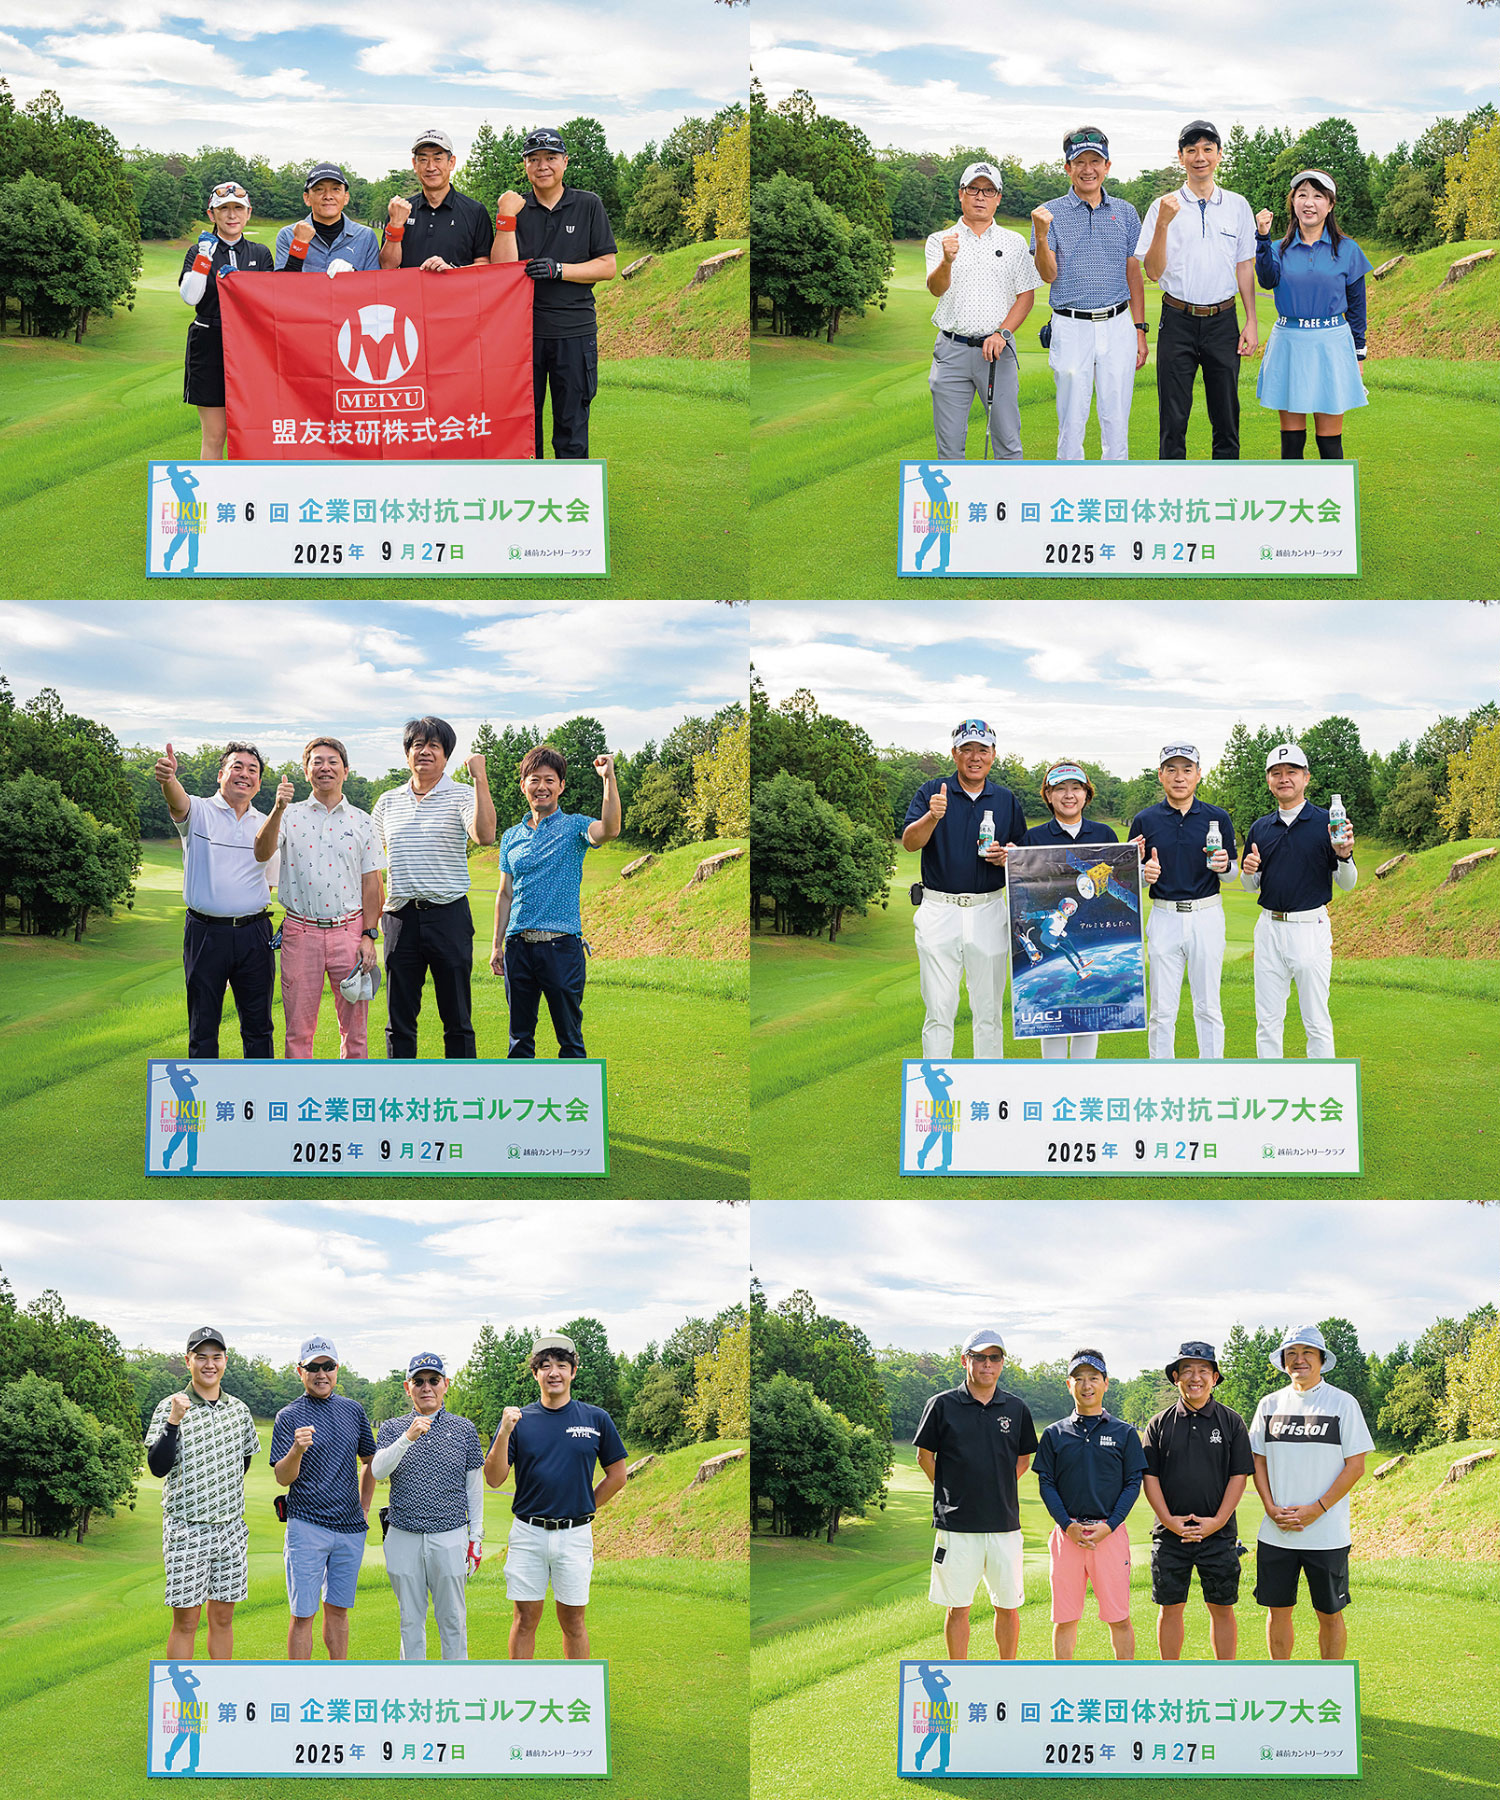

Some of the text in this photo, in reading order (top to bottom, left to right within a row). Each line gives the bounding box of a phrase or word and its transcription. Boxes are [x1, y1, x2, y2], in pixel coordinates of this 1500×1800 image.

[341, 392, 419, 408] MEIYU
[272, 412, 492, 446] 盟友技研株式会社
[162, 502, 207, 520] FUKUI
[913, 501, 958, 519] FUKUI
[162, 526, 207, 534] TOURNAMENT
[913, 525, 958, 534] TOURNAMENT
[524, 549, 591, 557] 越前カントリークラブ
[1275, 549, 1342, 558] 越前カントリークラブ
[1278, 748, 1288, 760] P
[1021, 1010, 1062, 1024] UACJ
[160, 1100, 206, 1118] FUKUI
[916, 1100, 961, 1118] FUKUI
[160, 1124, 206, 1132] TOURNAMENT
[915, 1124, 960, 1132] TOURNAMENT
[523, 1148, 590, 1156] 越前カントリークラブ
[1278, 1148, 1345, 1156] 越前カントリークラブ
[1272, 1421, 1329, 1436] Bristol
[163, 1702, 208, 1719] FUKUI
[913, 1701, 958, 1719] FUKUI
[162, 1725, 208, 1734] TOURNAMENT
[913, 1725, 958, 1734] TOURNAMENT
[525, 1749, 592, 1758] 越前カントリークラブ
[1276, 1750, 1343, 1758] 越前カントリークラブ
